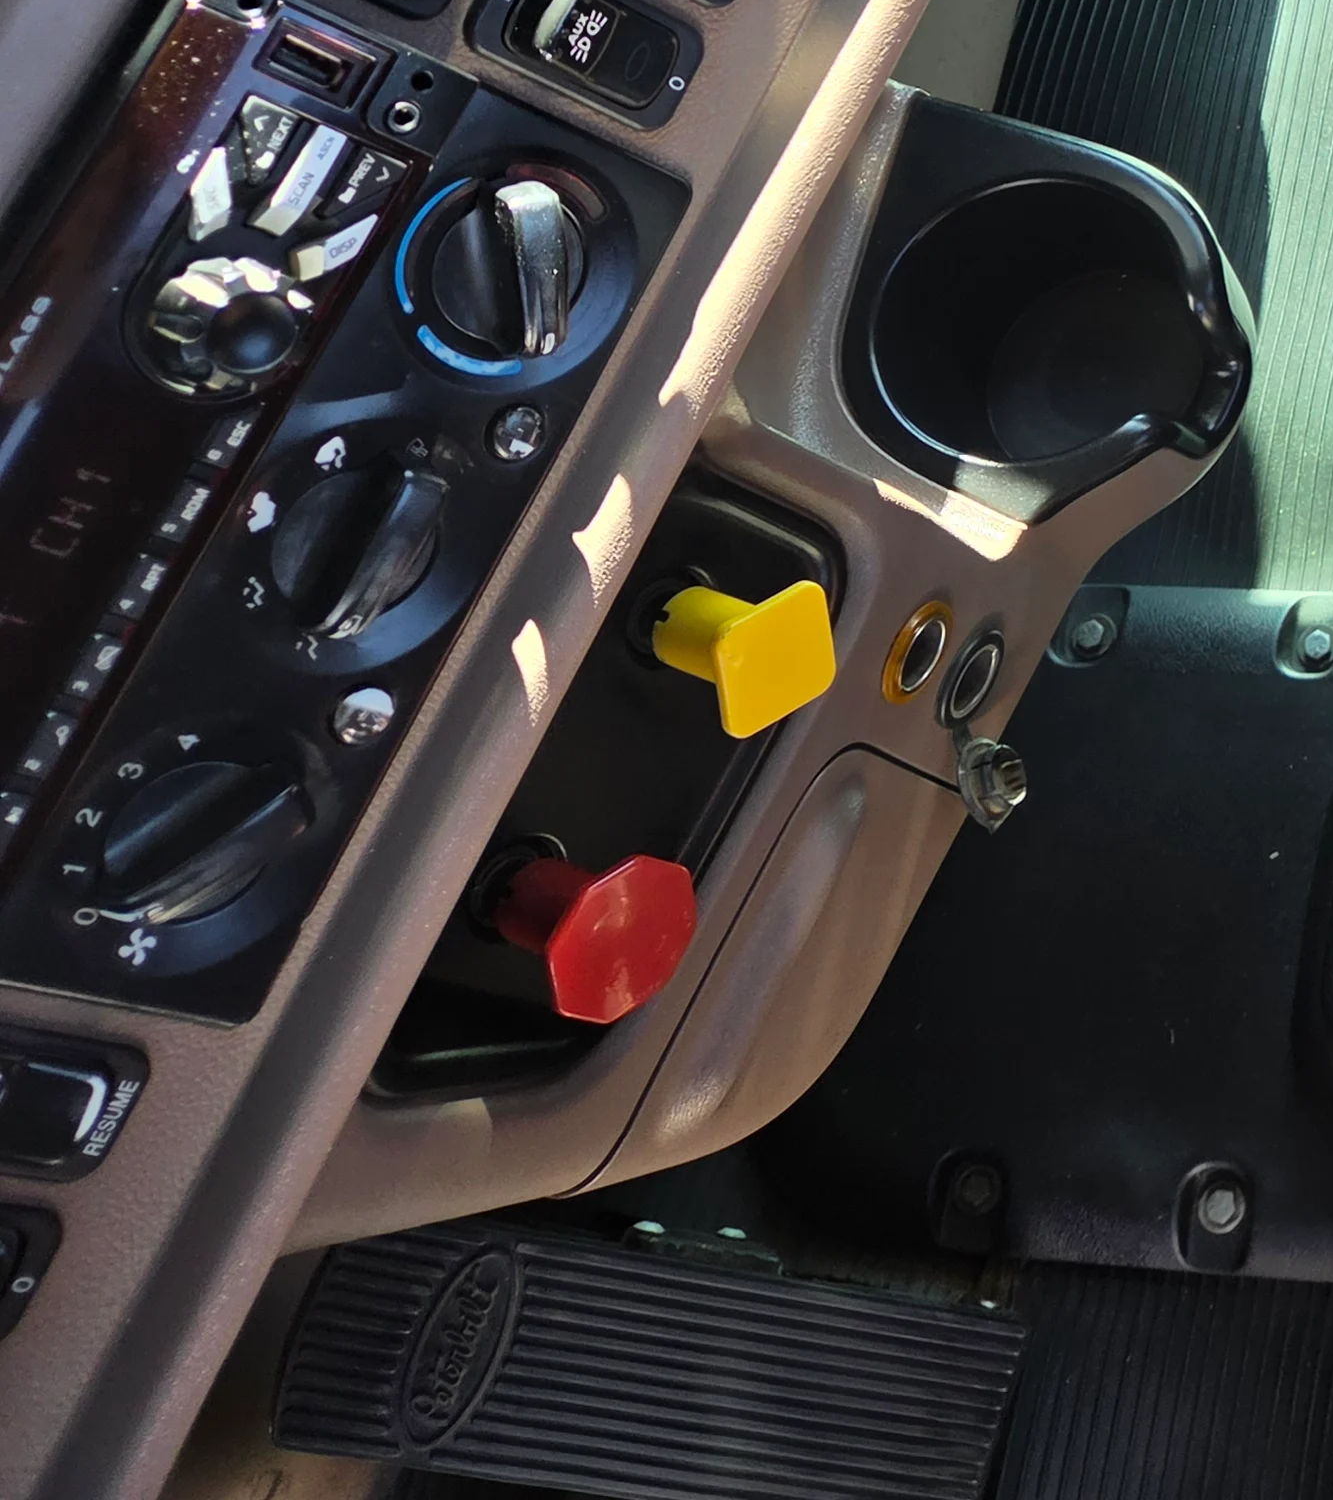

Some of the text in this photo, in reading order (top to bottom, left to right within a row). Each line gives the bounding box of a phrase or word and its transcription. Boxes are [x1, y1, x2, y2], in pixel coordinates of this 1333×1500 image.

[568, 13, 589, 47] AUX
[266, 116, 294, 150] NEXT
[348, 152, 376, 188] PREV
[288, 171, 315, 207] SCAN
[329, 237, 358, 259] DISP
[0, 296, 52, 386] LASS
[177, 734, 200, 751] 4
[117, 762, 144, 780] 3
[75, 807, 103, 828] 2
[62, 864, 87, 875] 1
[82, 1079, 140, 1157] RESUME
[411, 1262, 500, 1426] Peterbilt
